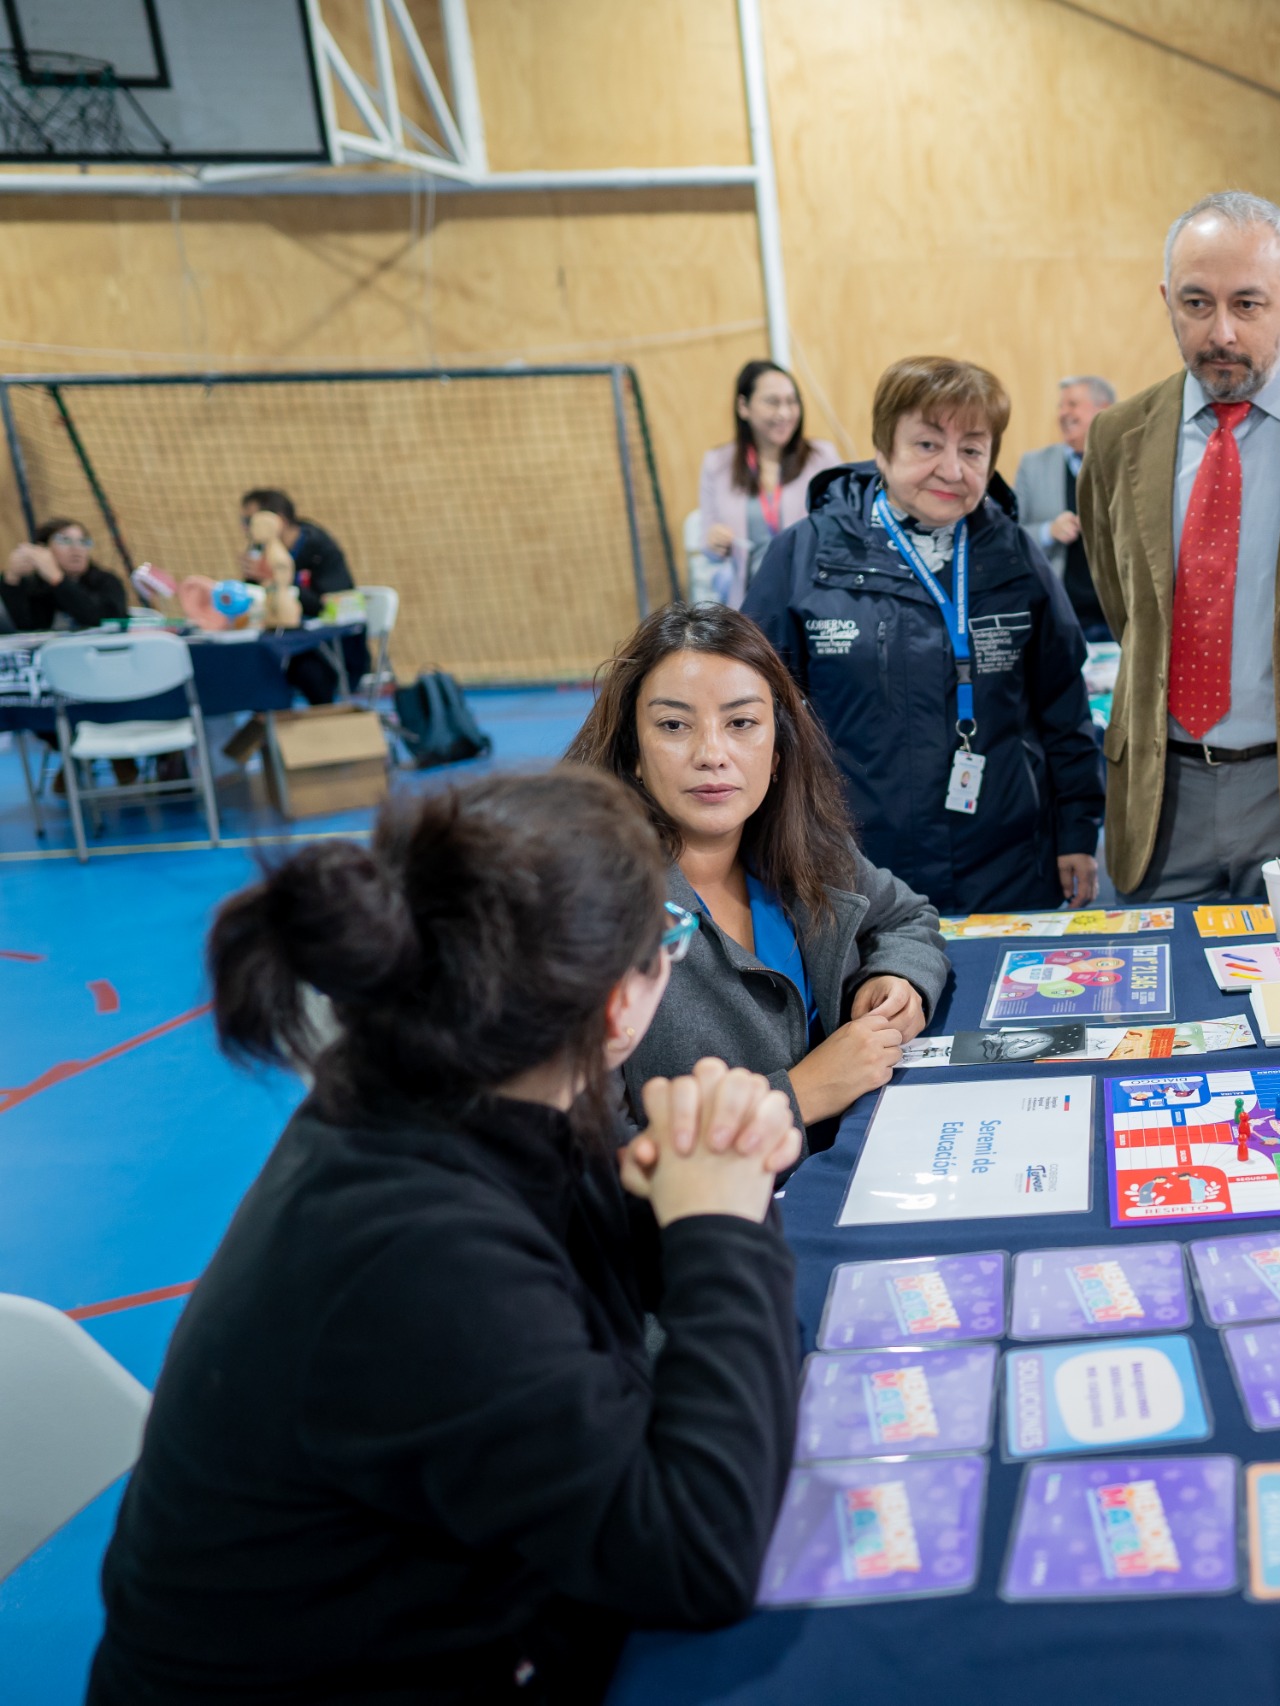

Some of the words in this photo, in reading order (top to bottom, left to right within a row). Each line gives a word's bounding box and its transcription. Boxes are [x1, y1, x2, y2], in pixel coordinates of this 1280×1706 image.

[805, 619, 857, 631] GOBIERNO
[932, 1121, 964, 1176] Educación
[974, 1119, 1001, 1156] Seremi
[971, 1157, 996, 1174] de
[1144, 1204, 1210, 1215] RESPETO
[1017, 1357, 1044, 1449] SOLUCIONES
